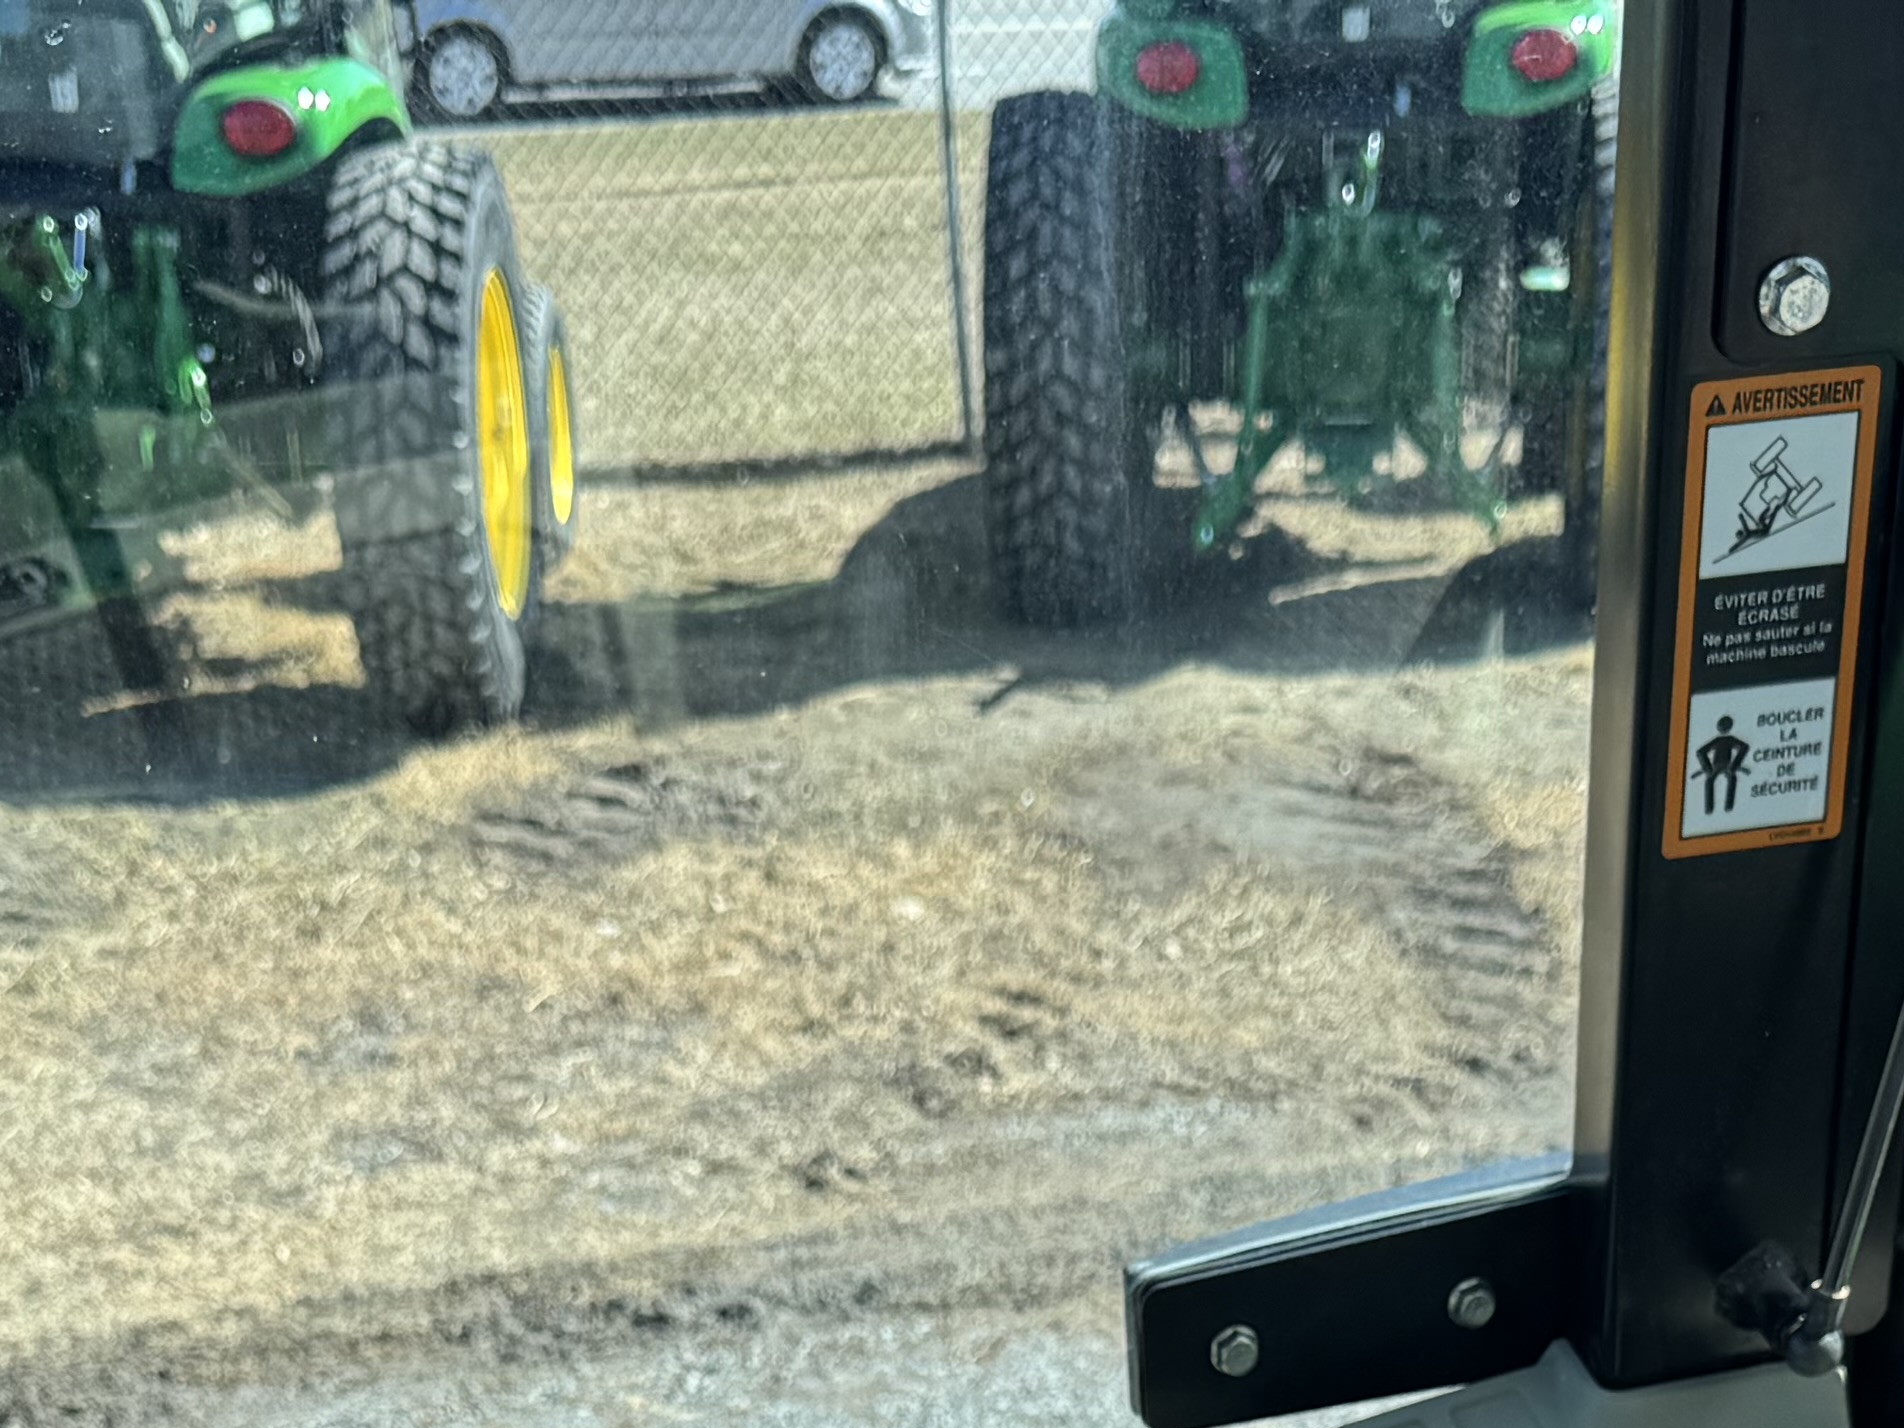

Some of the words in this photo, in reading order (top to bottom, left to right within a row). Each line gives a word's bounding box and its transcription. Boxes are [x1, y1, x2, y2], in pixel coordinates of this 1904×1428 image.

[1732, 379, 1865, 413] AVERTISSEMENT
[1714, 590, 1769, 611] ÉVITER
[1772, 583, 1826, 604] D'ÊTRE
[1737, 602, 1800, 626] ÉCRASÉ
[1702, 633, 1722, 647] Ne
[1725, 631, 1752, 648] pas
[1755, 625, 1800, 643] sauter
[1819, 620, 1833, 634] la
[1706, 647, 1767, 666] machine
[1770, 640, 1826, 658] bascule
[1757, 707, 1824, 727] BOUCLER
[1780, 728, 1797, 741] LA
[1753, 742, 1822, 762] CEINTURE
[1777, 763, 1795, 777] DE
[1751, 776, 1819, 798] SÉCURITÉ
